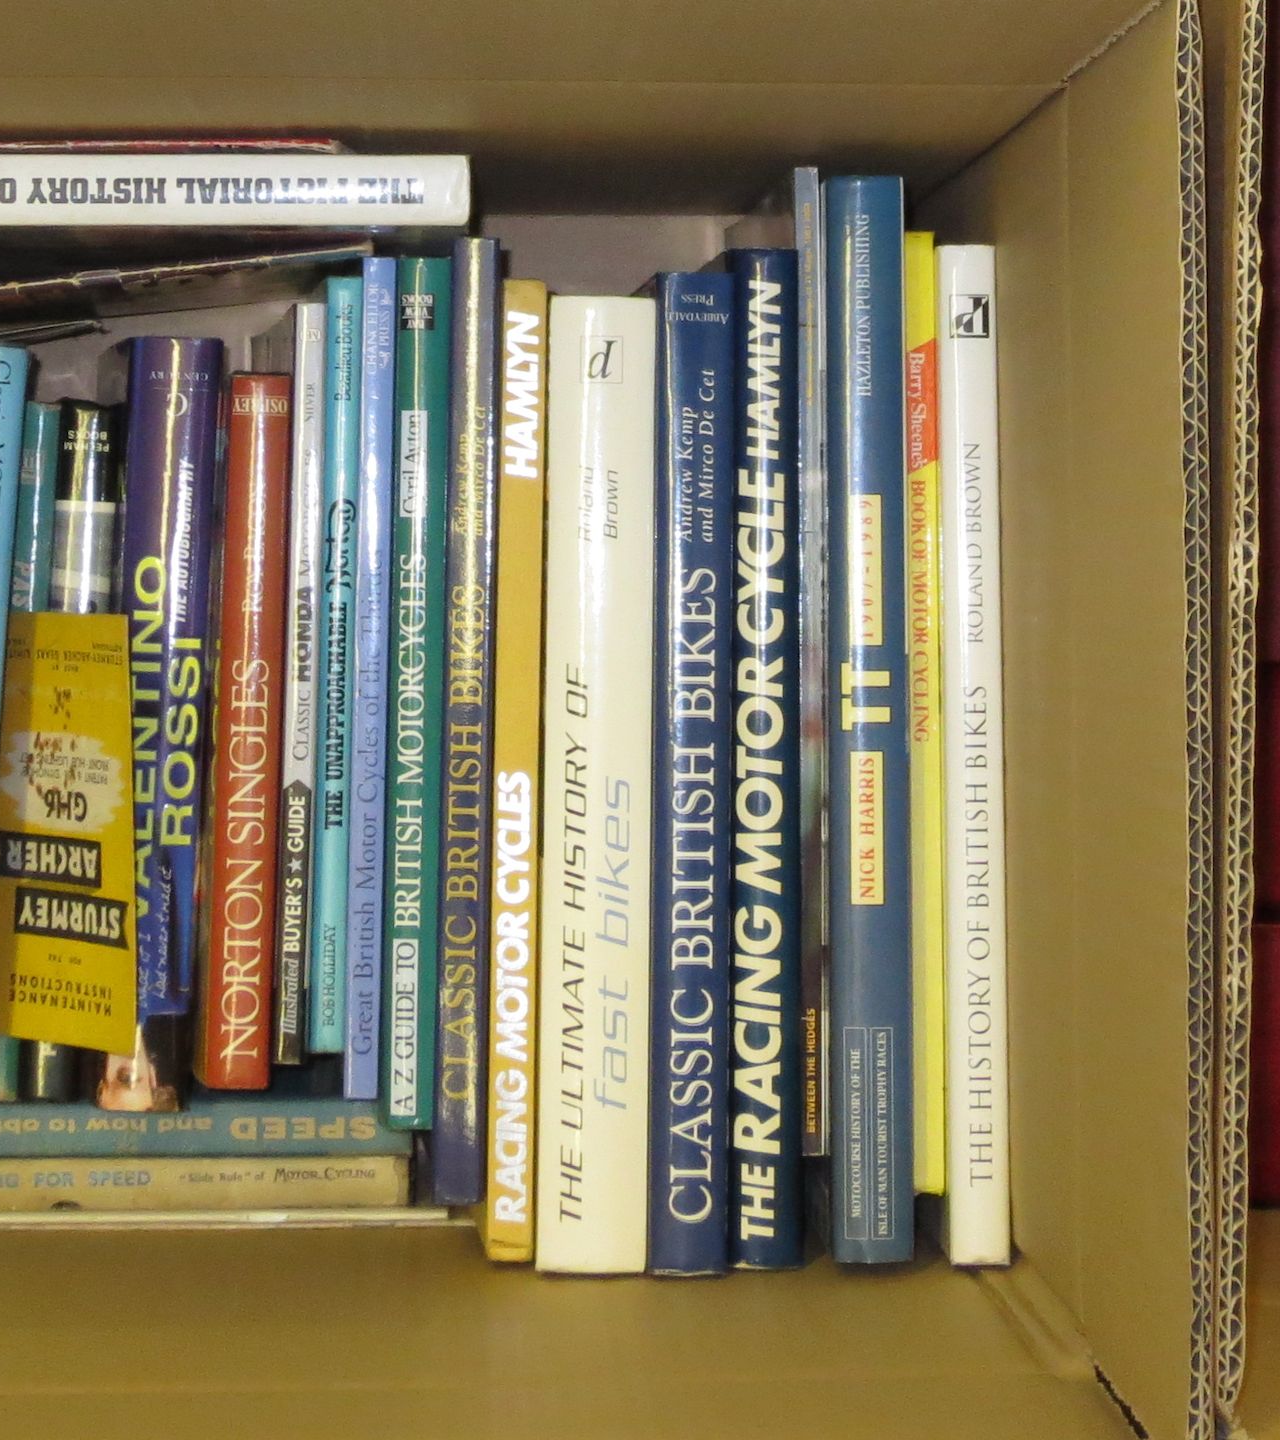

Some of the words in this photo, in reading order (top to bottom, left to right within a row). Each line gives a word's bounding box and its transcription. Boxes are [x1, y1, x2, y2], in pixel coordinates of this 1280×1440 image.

[26, 176, 167, 205] HISTORY
[176, 177, 348, 204] PICTORIAL
[358, 178, 424, 204] THE
[856, 214, 871, 310] PUBLISHING
[504, 310, 539, 480] HAMLYN
[700, 369, 716, 399] Cet
[746, 279, 782, 461] HAMLYN
[855, 312, 872, 398] HAZLETON
[681, 407, 699, 458] Kemp
[700, 405, 715, 436] De
[678, 462, 694, 543] Andrew
[699, 443, 715, 503] Mirco
[965, 442, 983, 532] BROWN
[699, 509, 714, 543] and
[736, 467, 785, 646] CYCLE
[966, 542, 983, 643] ROLAND
[672, 567, 716, 723] BIKES
[566, 663, 588, 718] OF
[841, 662, 891, 731] TT
[160, 638, 203, 847] ROSSI
[227, 659, 270, 847] SINGLES
[964, 685, 987, 777] BIKES
[44, 789, 88, 822] GH6
[735, 656, 784, 897] MOTOR
[860, 756, 876, 834] HARRIS
[7, 839, 98, 880] ARCHER
[496, 770, 532, 904] CYCLES
[563, 731, 587, 911] HISTORY
[671, 743, 716, 971] BRITISH
[966, 782, 990, 908] BRITISH
[595, 775, 630, 948] bikes
[859, 846, 875, 899] NICK
[18, 893, 122, 942] STURMEY
[967, 919, 991, 961] OF
[9, 973, 113, 1000] INSTRUCTIONS
[221, 858, 263, 1058] NORTON
[494, 910, 530, 1063] MOTOR
[7, 989, 113, 1017] MAINTENANCE
[561, 925, 586, 1133] ULTIMATE
[594, 973, 629, 1111] fast
[733, 903, 784, 1155] RACING
[806, 1008, 816, 1053] HEDGES
[967, 969, 992, 1113] HISTORY
[806, 1056, 816, 1076] THE
[850, 1048, 861, 1071] THE
[850, 1073, 861, 1087] OF
[669, 987, 715, 1226] CLASSIC
[806, 1079, 816, 1134] BETWEEN
[850, 1091, 861, 1139] HISTORY
[34, 1171, 76, 1189] FOR
[88, 1169, 151, 1187] SPEED
[494, 1071, 529, 1225] RACING
[558, 1144, 583, 1224] THE
[851, 1141, 861, 1218] MOTOCOURSE
[968, 1122, 993, 1188] THE
[740, 1161, 774, 1242] THE
